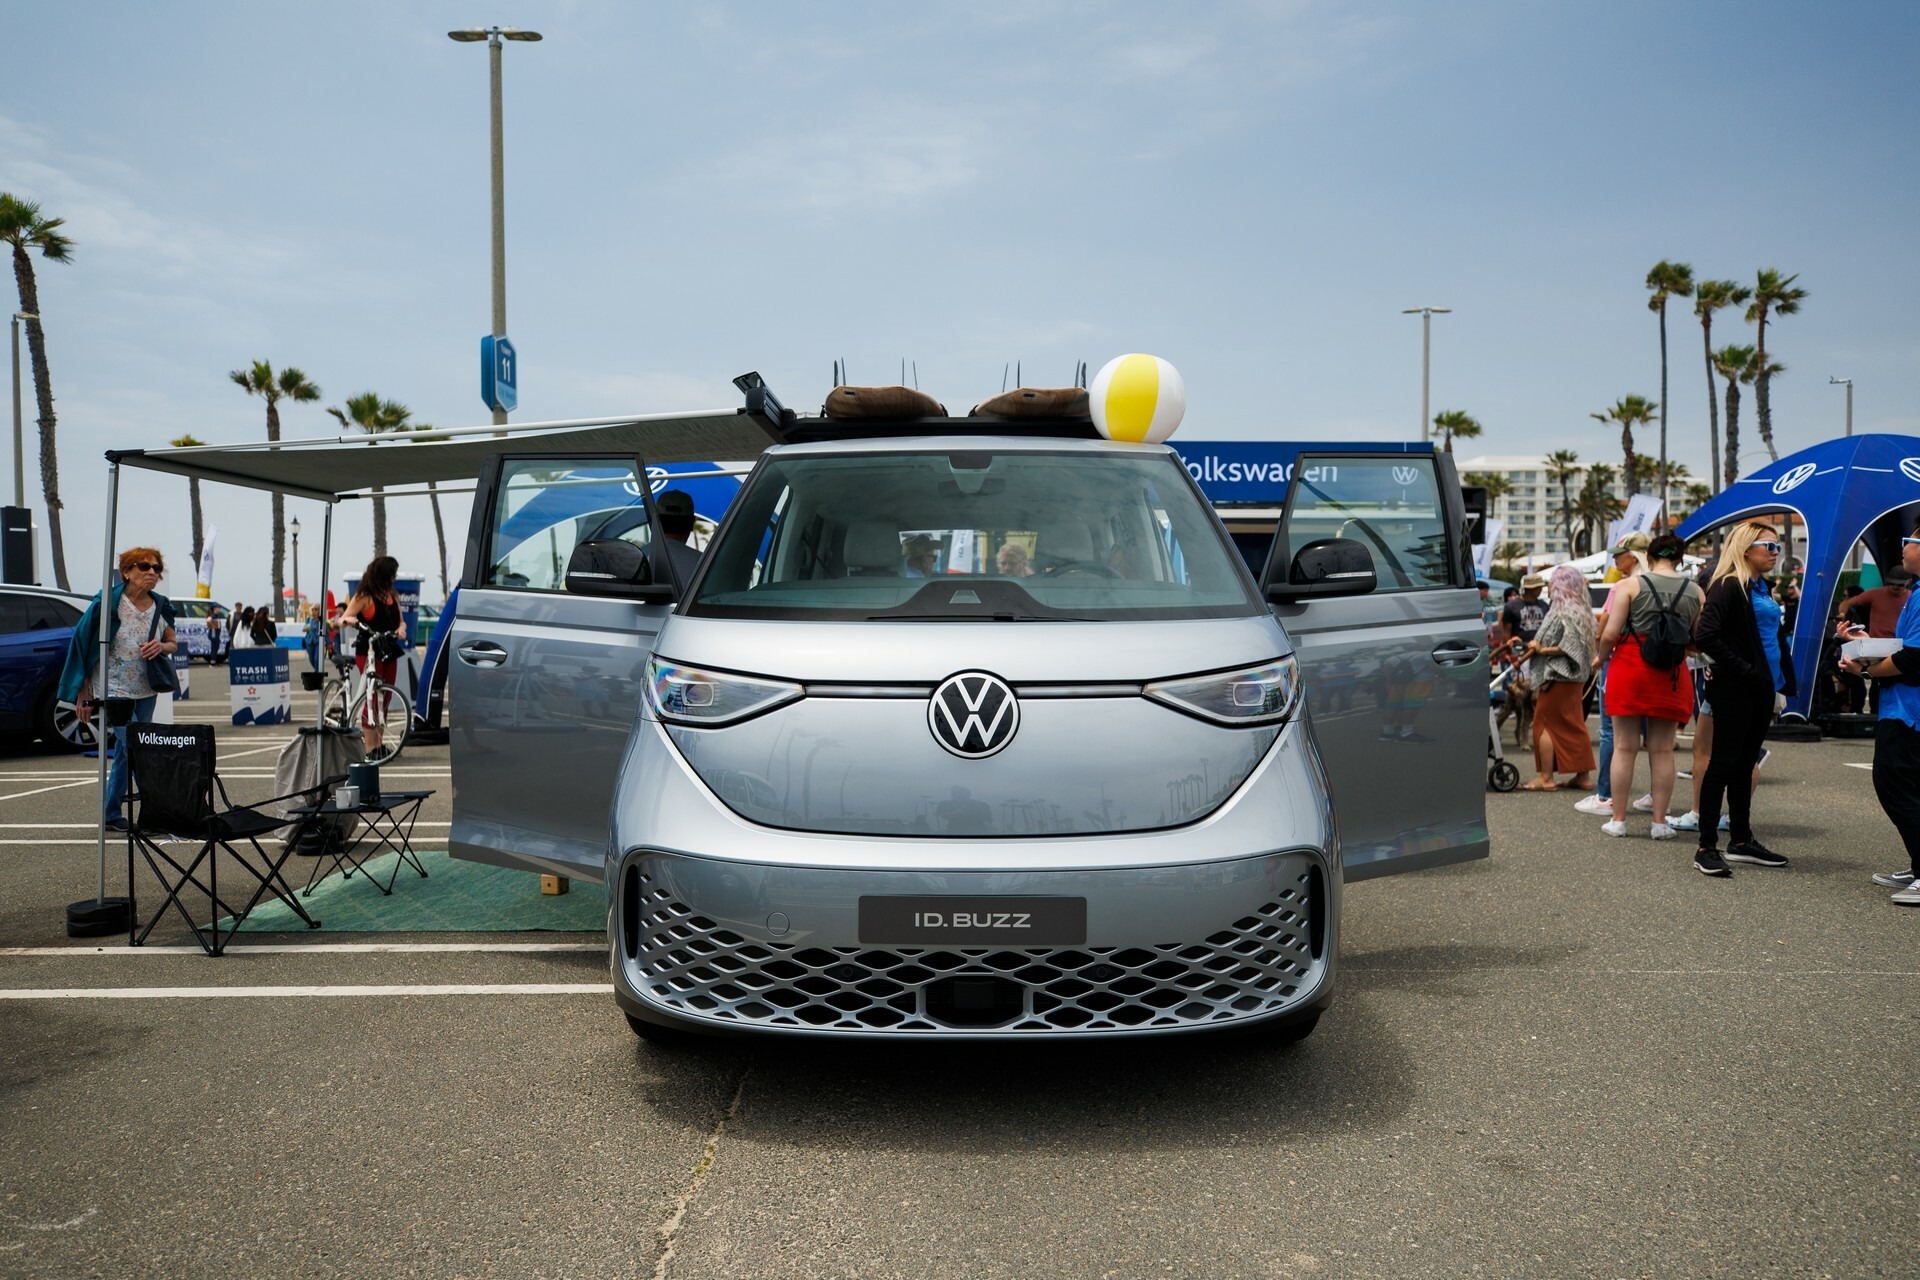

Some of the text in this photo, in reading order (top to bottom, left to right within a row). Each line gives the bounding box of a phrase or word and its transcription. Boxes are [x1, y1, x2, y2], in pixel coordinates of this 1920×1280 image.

[502, 358, 511, 382] 11
[235, 666, 267, 674] TRASH
[929, 672, 1019, 758] VW
[138, 732, 196, 748] Volkswagen
